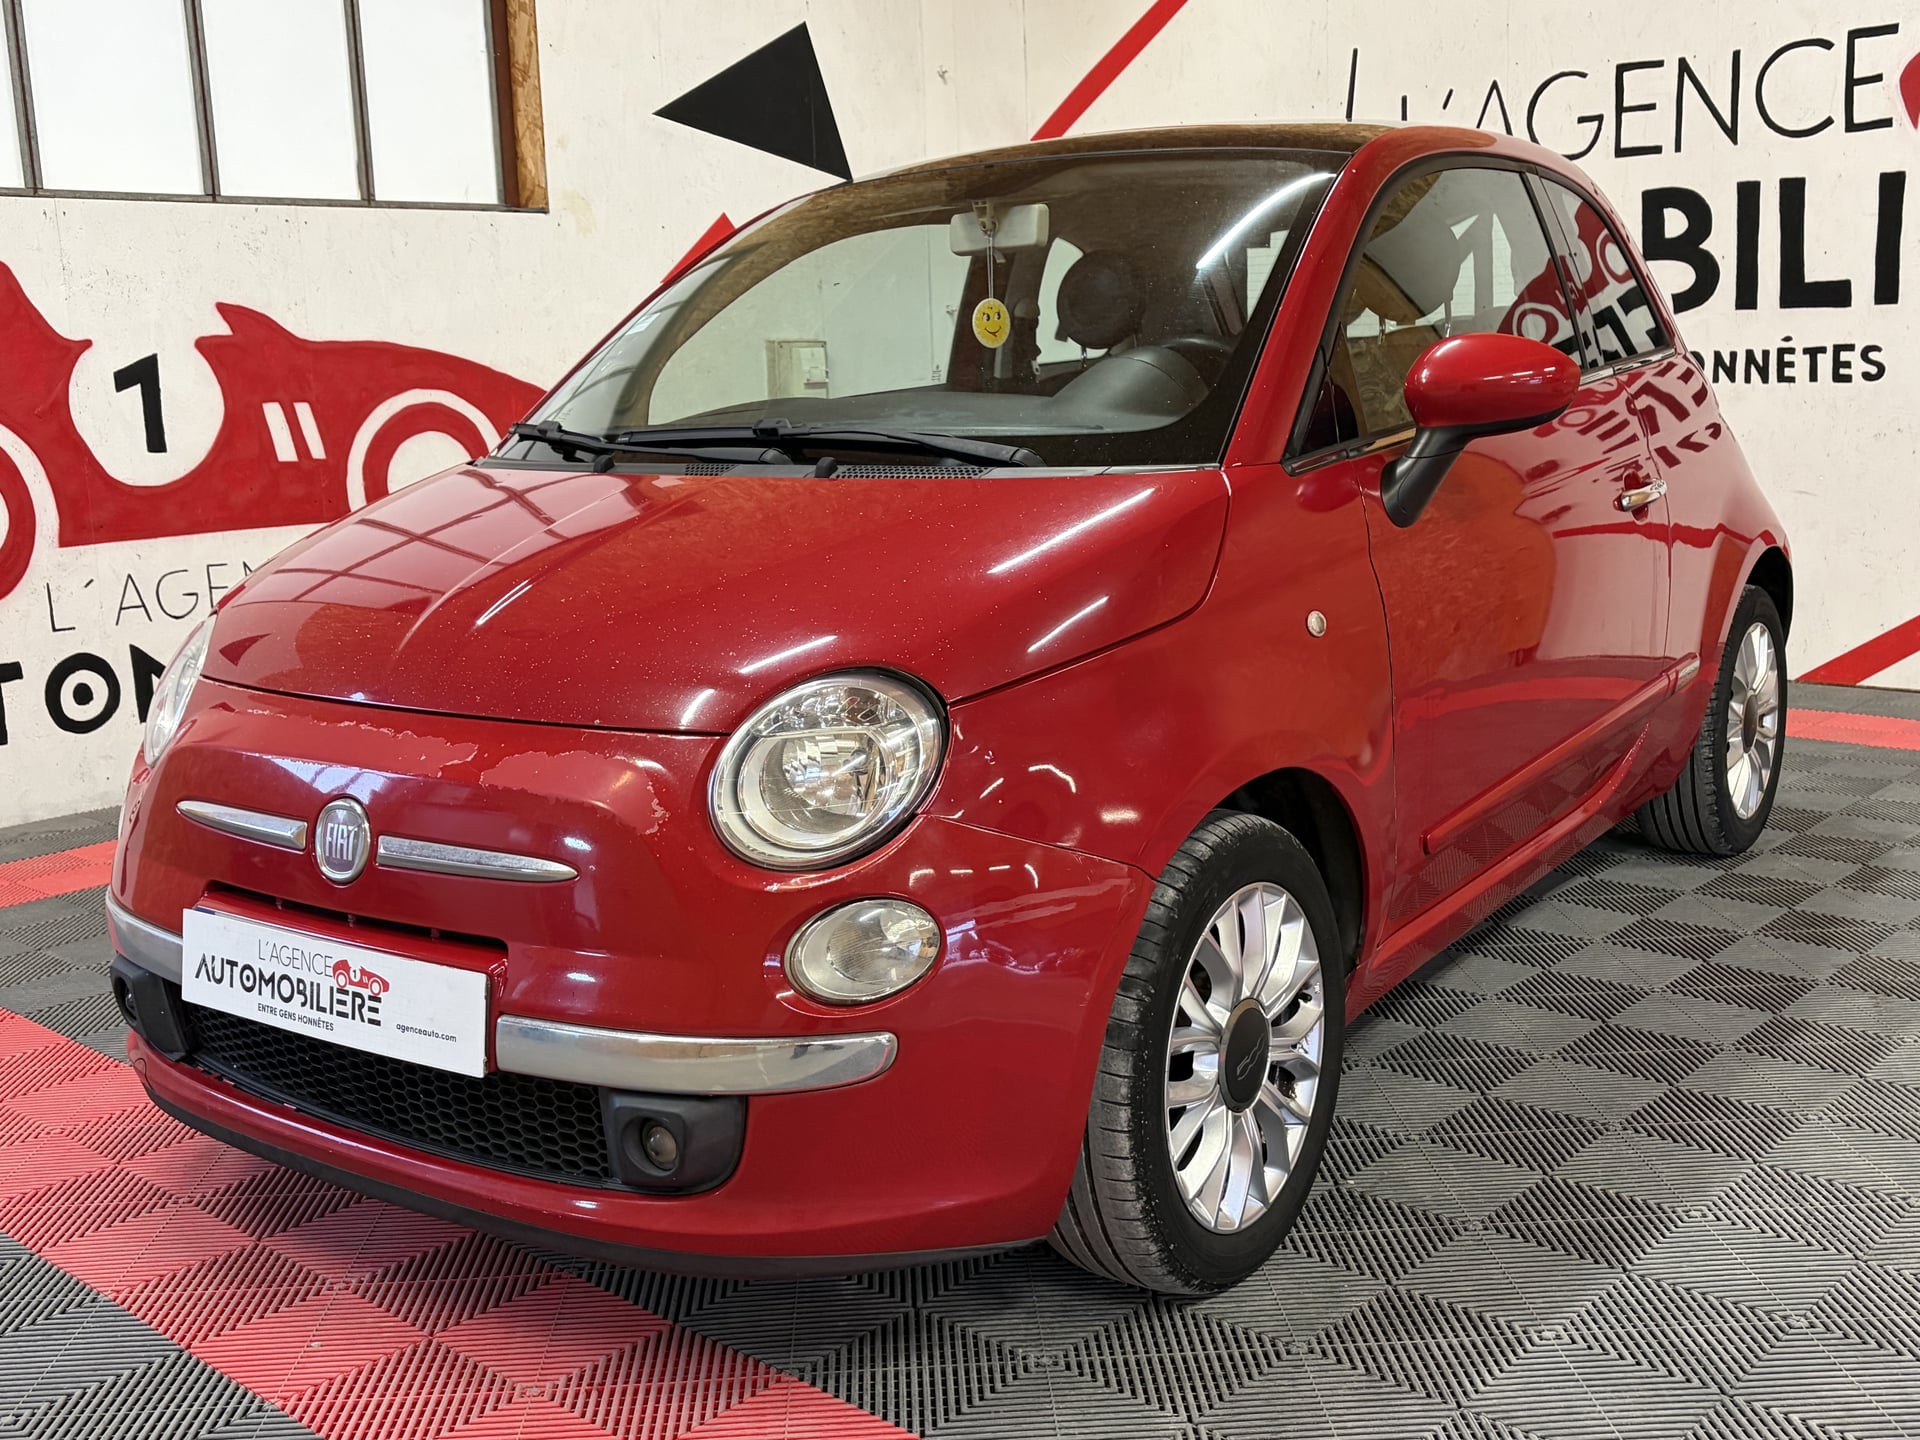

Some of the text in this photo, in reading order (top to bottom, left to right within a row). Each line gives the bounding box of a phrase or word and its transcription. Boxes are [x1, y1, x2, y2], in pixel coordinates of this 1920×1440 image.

[113, 353, 168, 454] 1
[325, 822, 358, 861] FIAT
[258, 938, 334, 978] L'AGENCE
[257, 1003, 334, 1032] ENTRE GENS HONNÊTES
[396, 1023, 457, 1042] agenceauto.com
